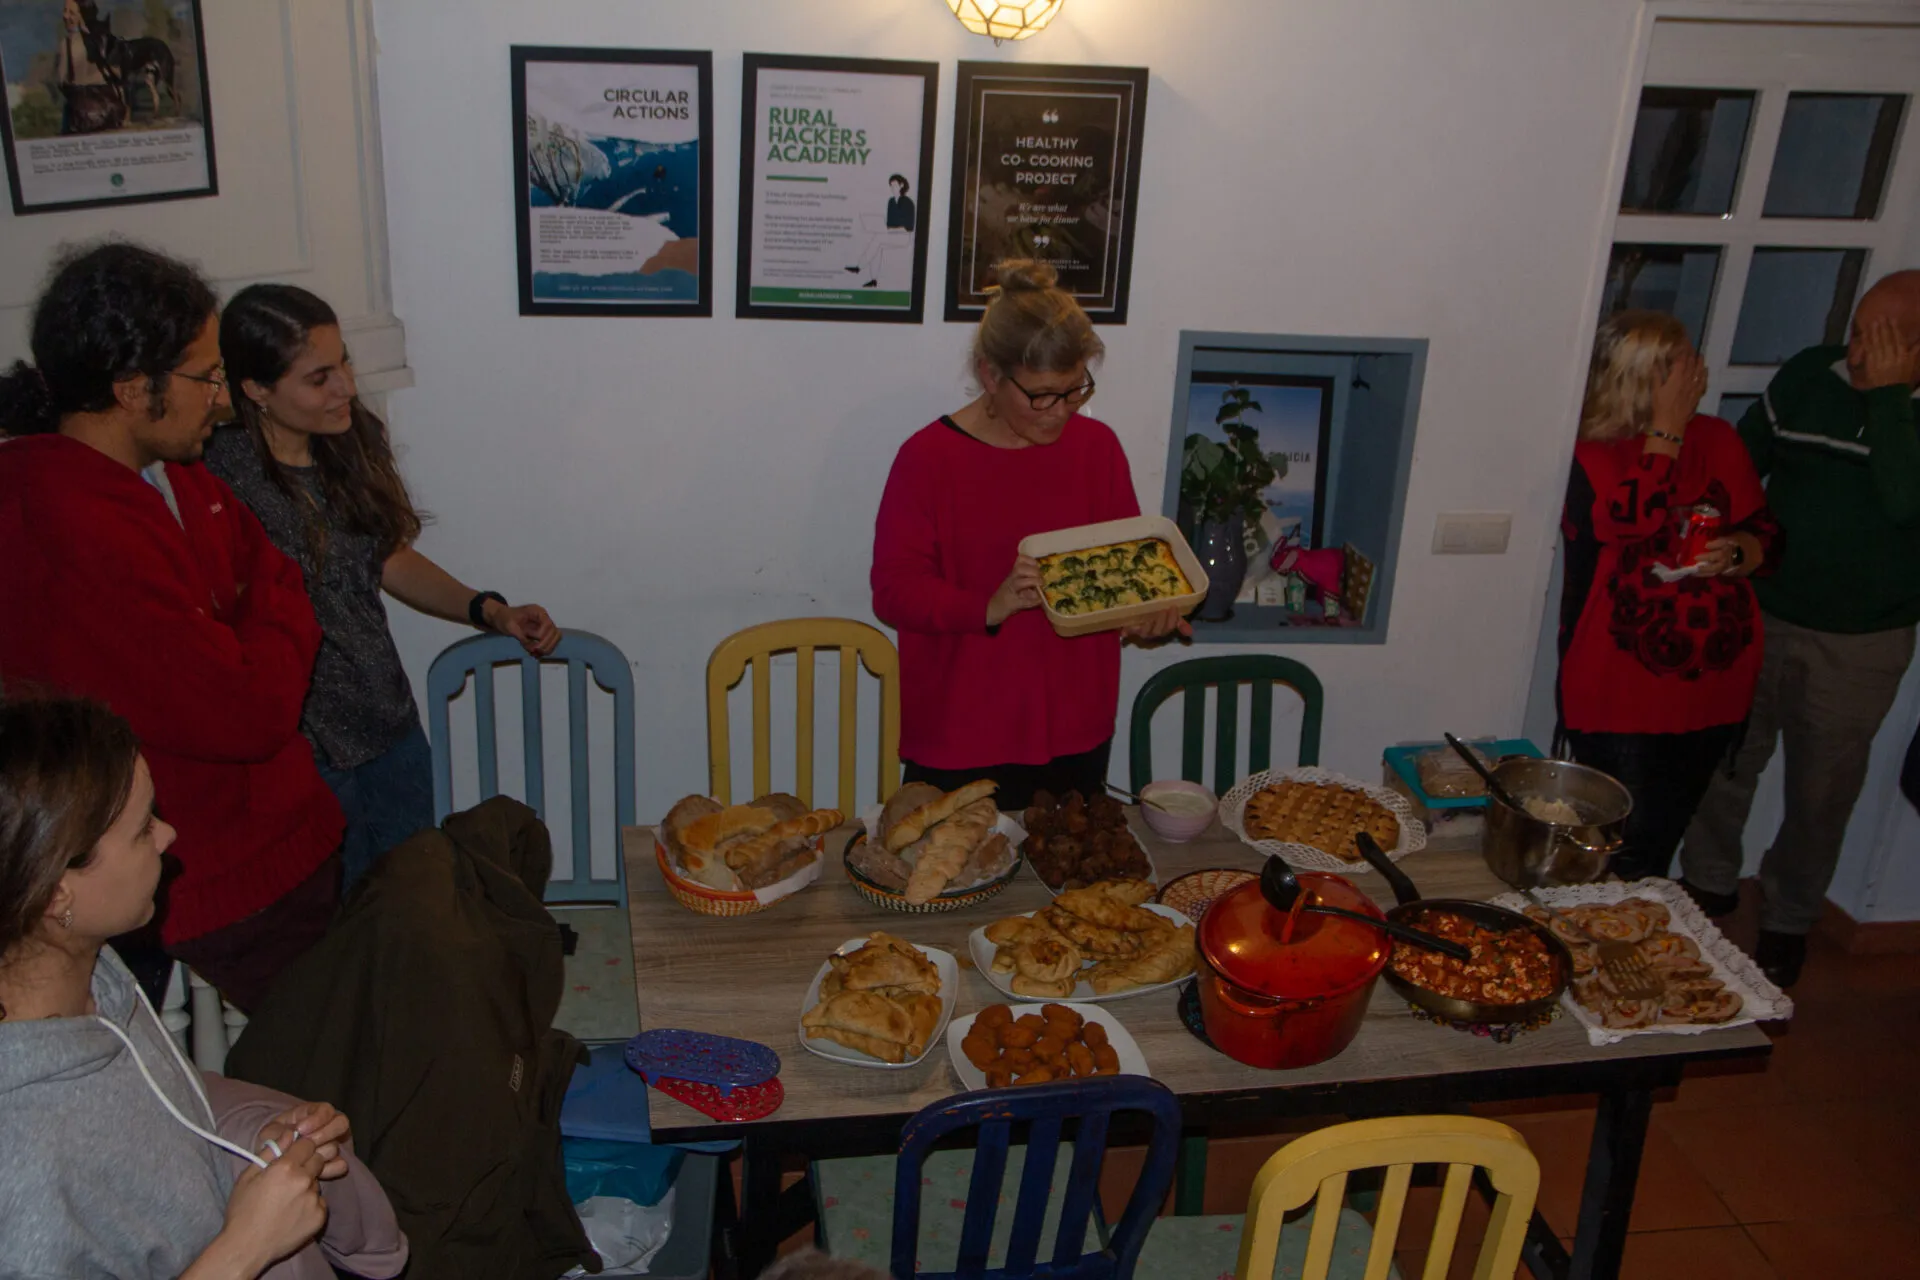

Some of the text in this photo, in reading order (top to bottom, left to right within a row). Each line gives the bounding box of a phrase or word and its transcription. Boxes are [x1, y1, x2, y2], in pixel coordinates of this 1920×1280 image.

[604, 88, 689, 104] CIRCULAR
[613, 104, 689, 120] ACTIONS
[770, 106, 837, 127] RURAL
[768, 126, 866, 146] HACKERS
[1016, 136, 1078, 150] HEALTHY
[768, 144, 872, 165] ACADEMY
[1029, 155, 1094, 167] COOKING
[1016, 172, 1076, 185] PROJECT
[1053, 214, 1080, 224] dinner
